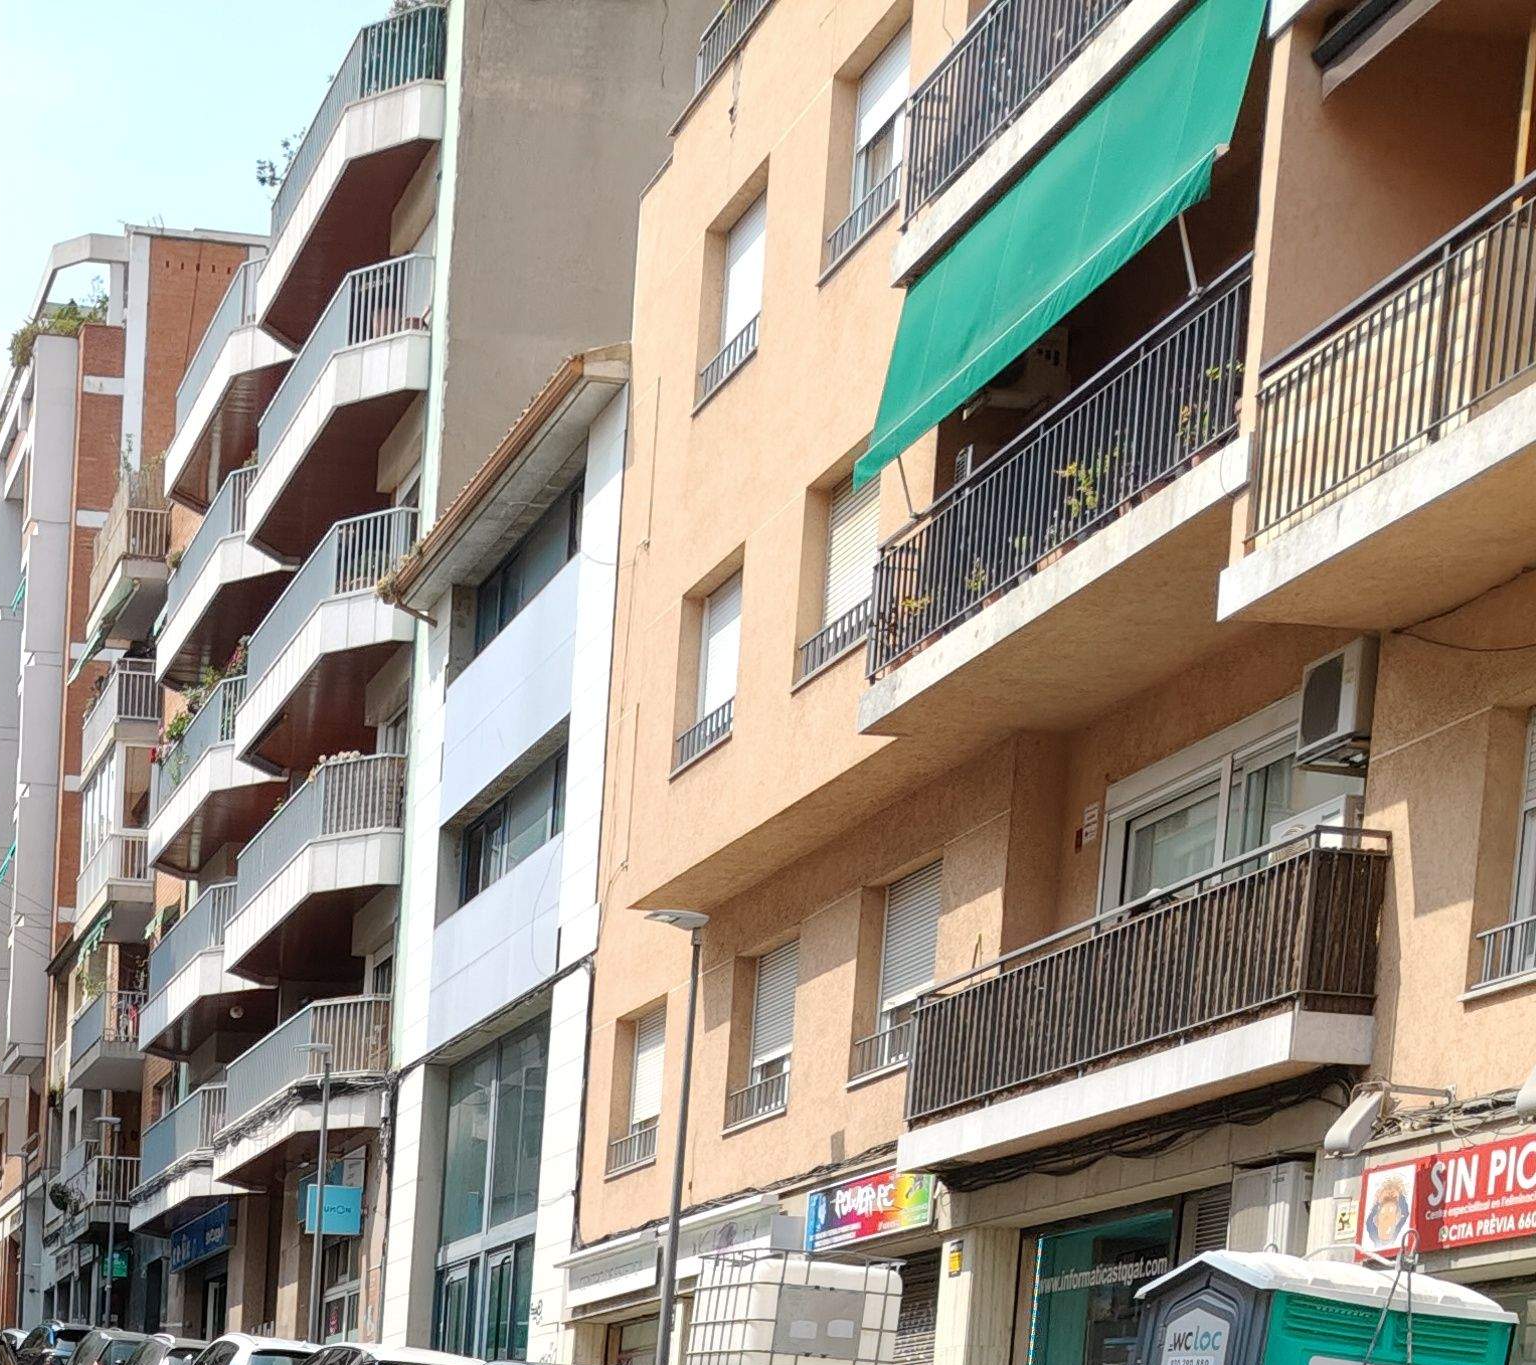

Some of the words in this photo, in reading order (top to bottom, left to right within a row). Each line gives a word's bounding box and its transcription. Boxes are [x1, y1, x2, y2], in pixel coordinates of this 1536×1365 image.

[1427, 1153, 1479, 1207] SIN
[1449, 1221, 1473, 1241] CITA
[1476, 1213, 1515, 1237] PRÈVIA
